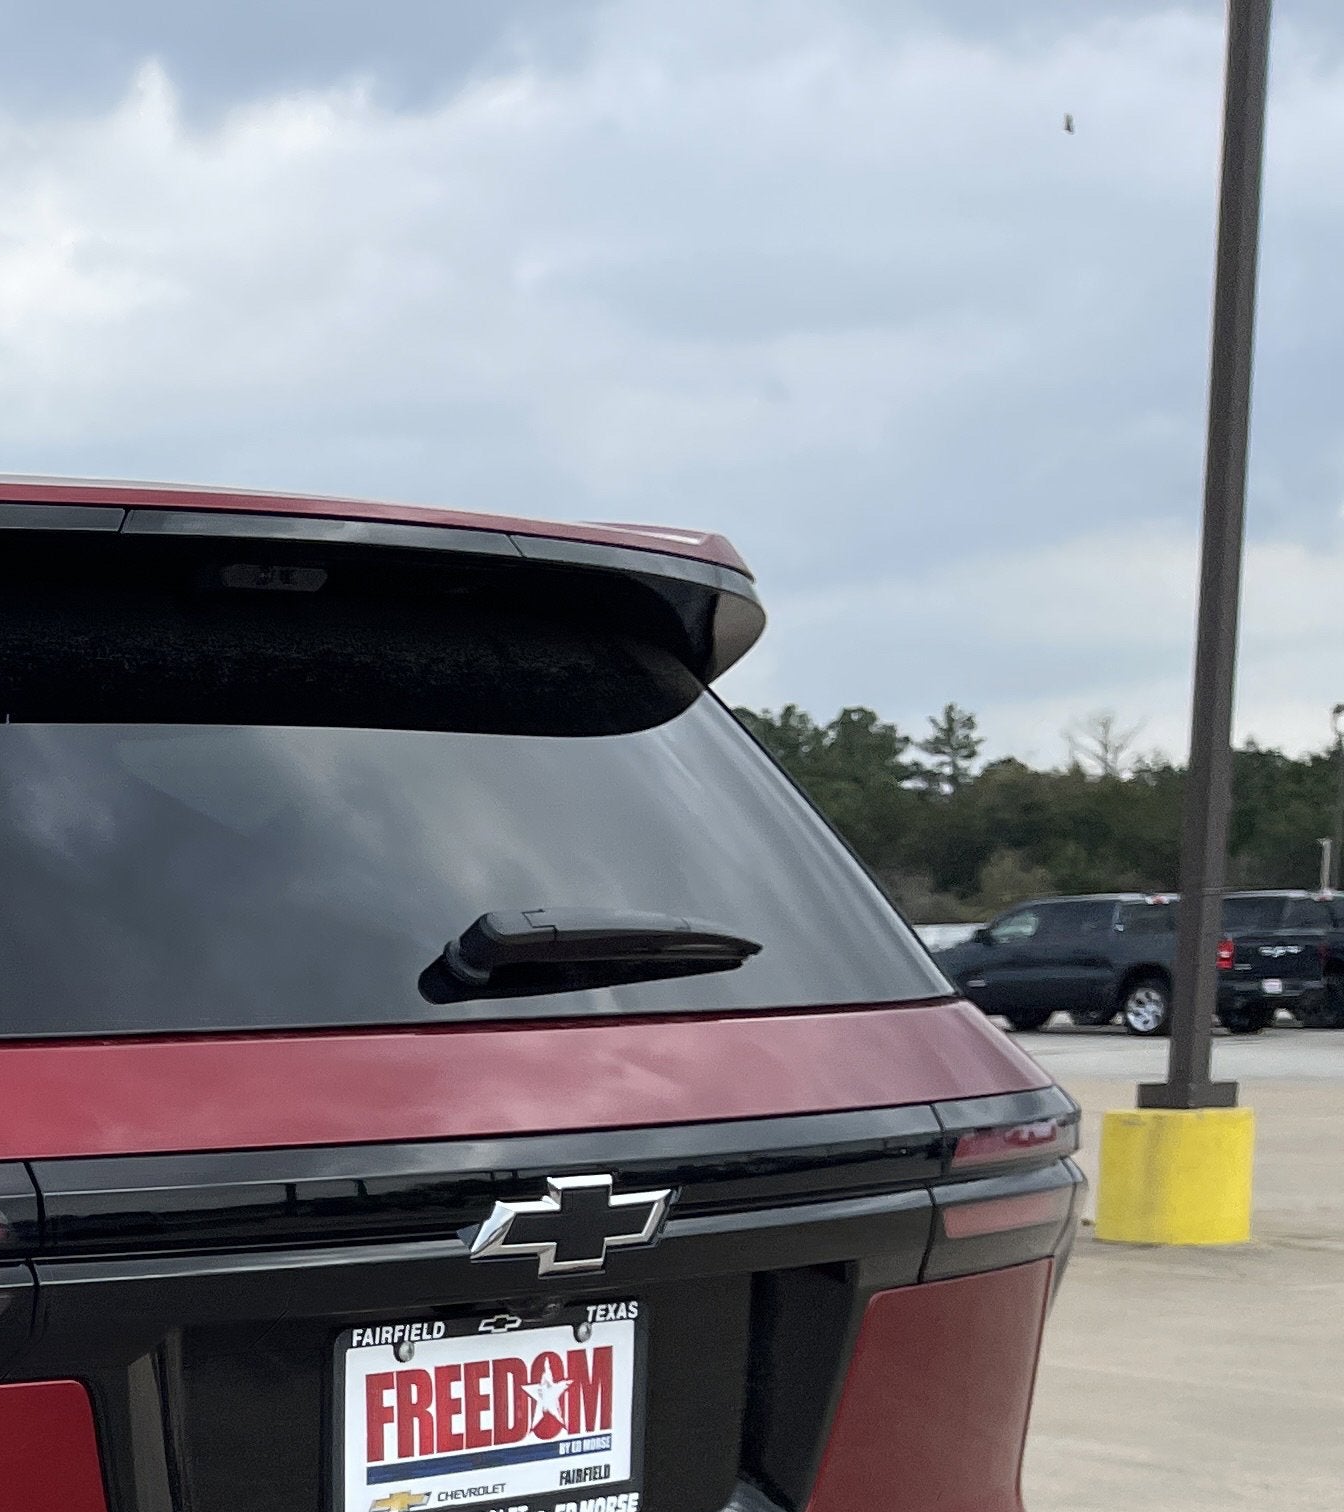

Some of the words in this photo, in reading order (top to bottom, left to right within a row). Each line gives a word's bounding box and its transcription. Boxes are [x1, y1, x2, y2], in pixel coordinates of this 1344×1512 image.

[586, 1301, 639, 1323] TEXAS
[352, 1321, 445, 1347] FAIRFIELD
[365, 1345, 613, 1463] FREEDOM
[559, 1464, 610, 1486] FAIRFIELD
[438, 1483, 506, 1501] CHEVROLET
